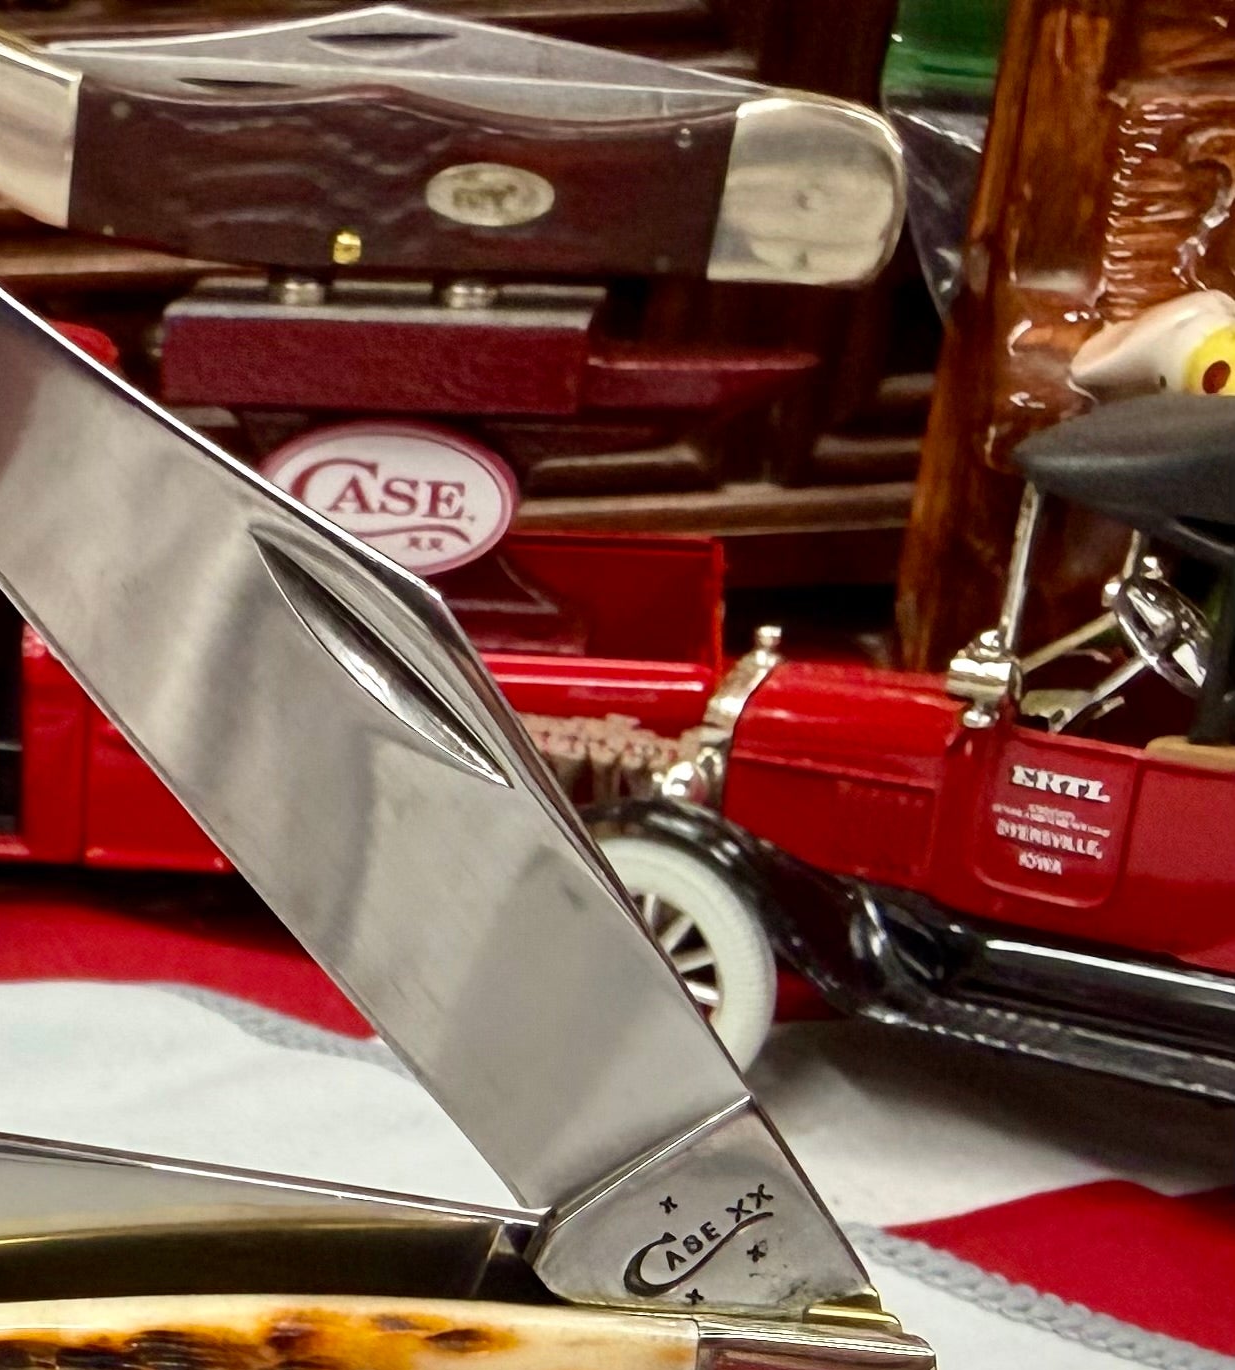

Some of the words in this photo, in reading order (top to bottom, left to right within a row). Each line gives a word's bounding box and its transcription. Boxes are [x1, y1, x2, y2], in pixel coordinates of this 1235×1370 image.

[289, 457, 470, 545] CASE
[1012, 765, 1111, 803] ERTL
[1018, 851, 1062, 875] IOWA
[725, 1183, 774, 1223] XX
